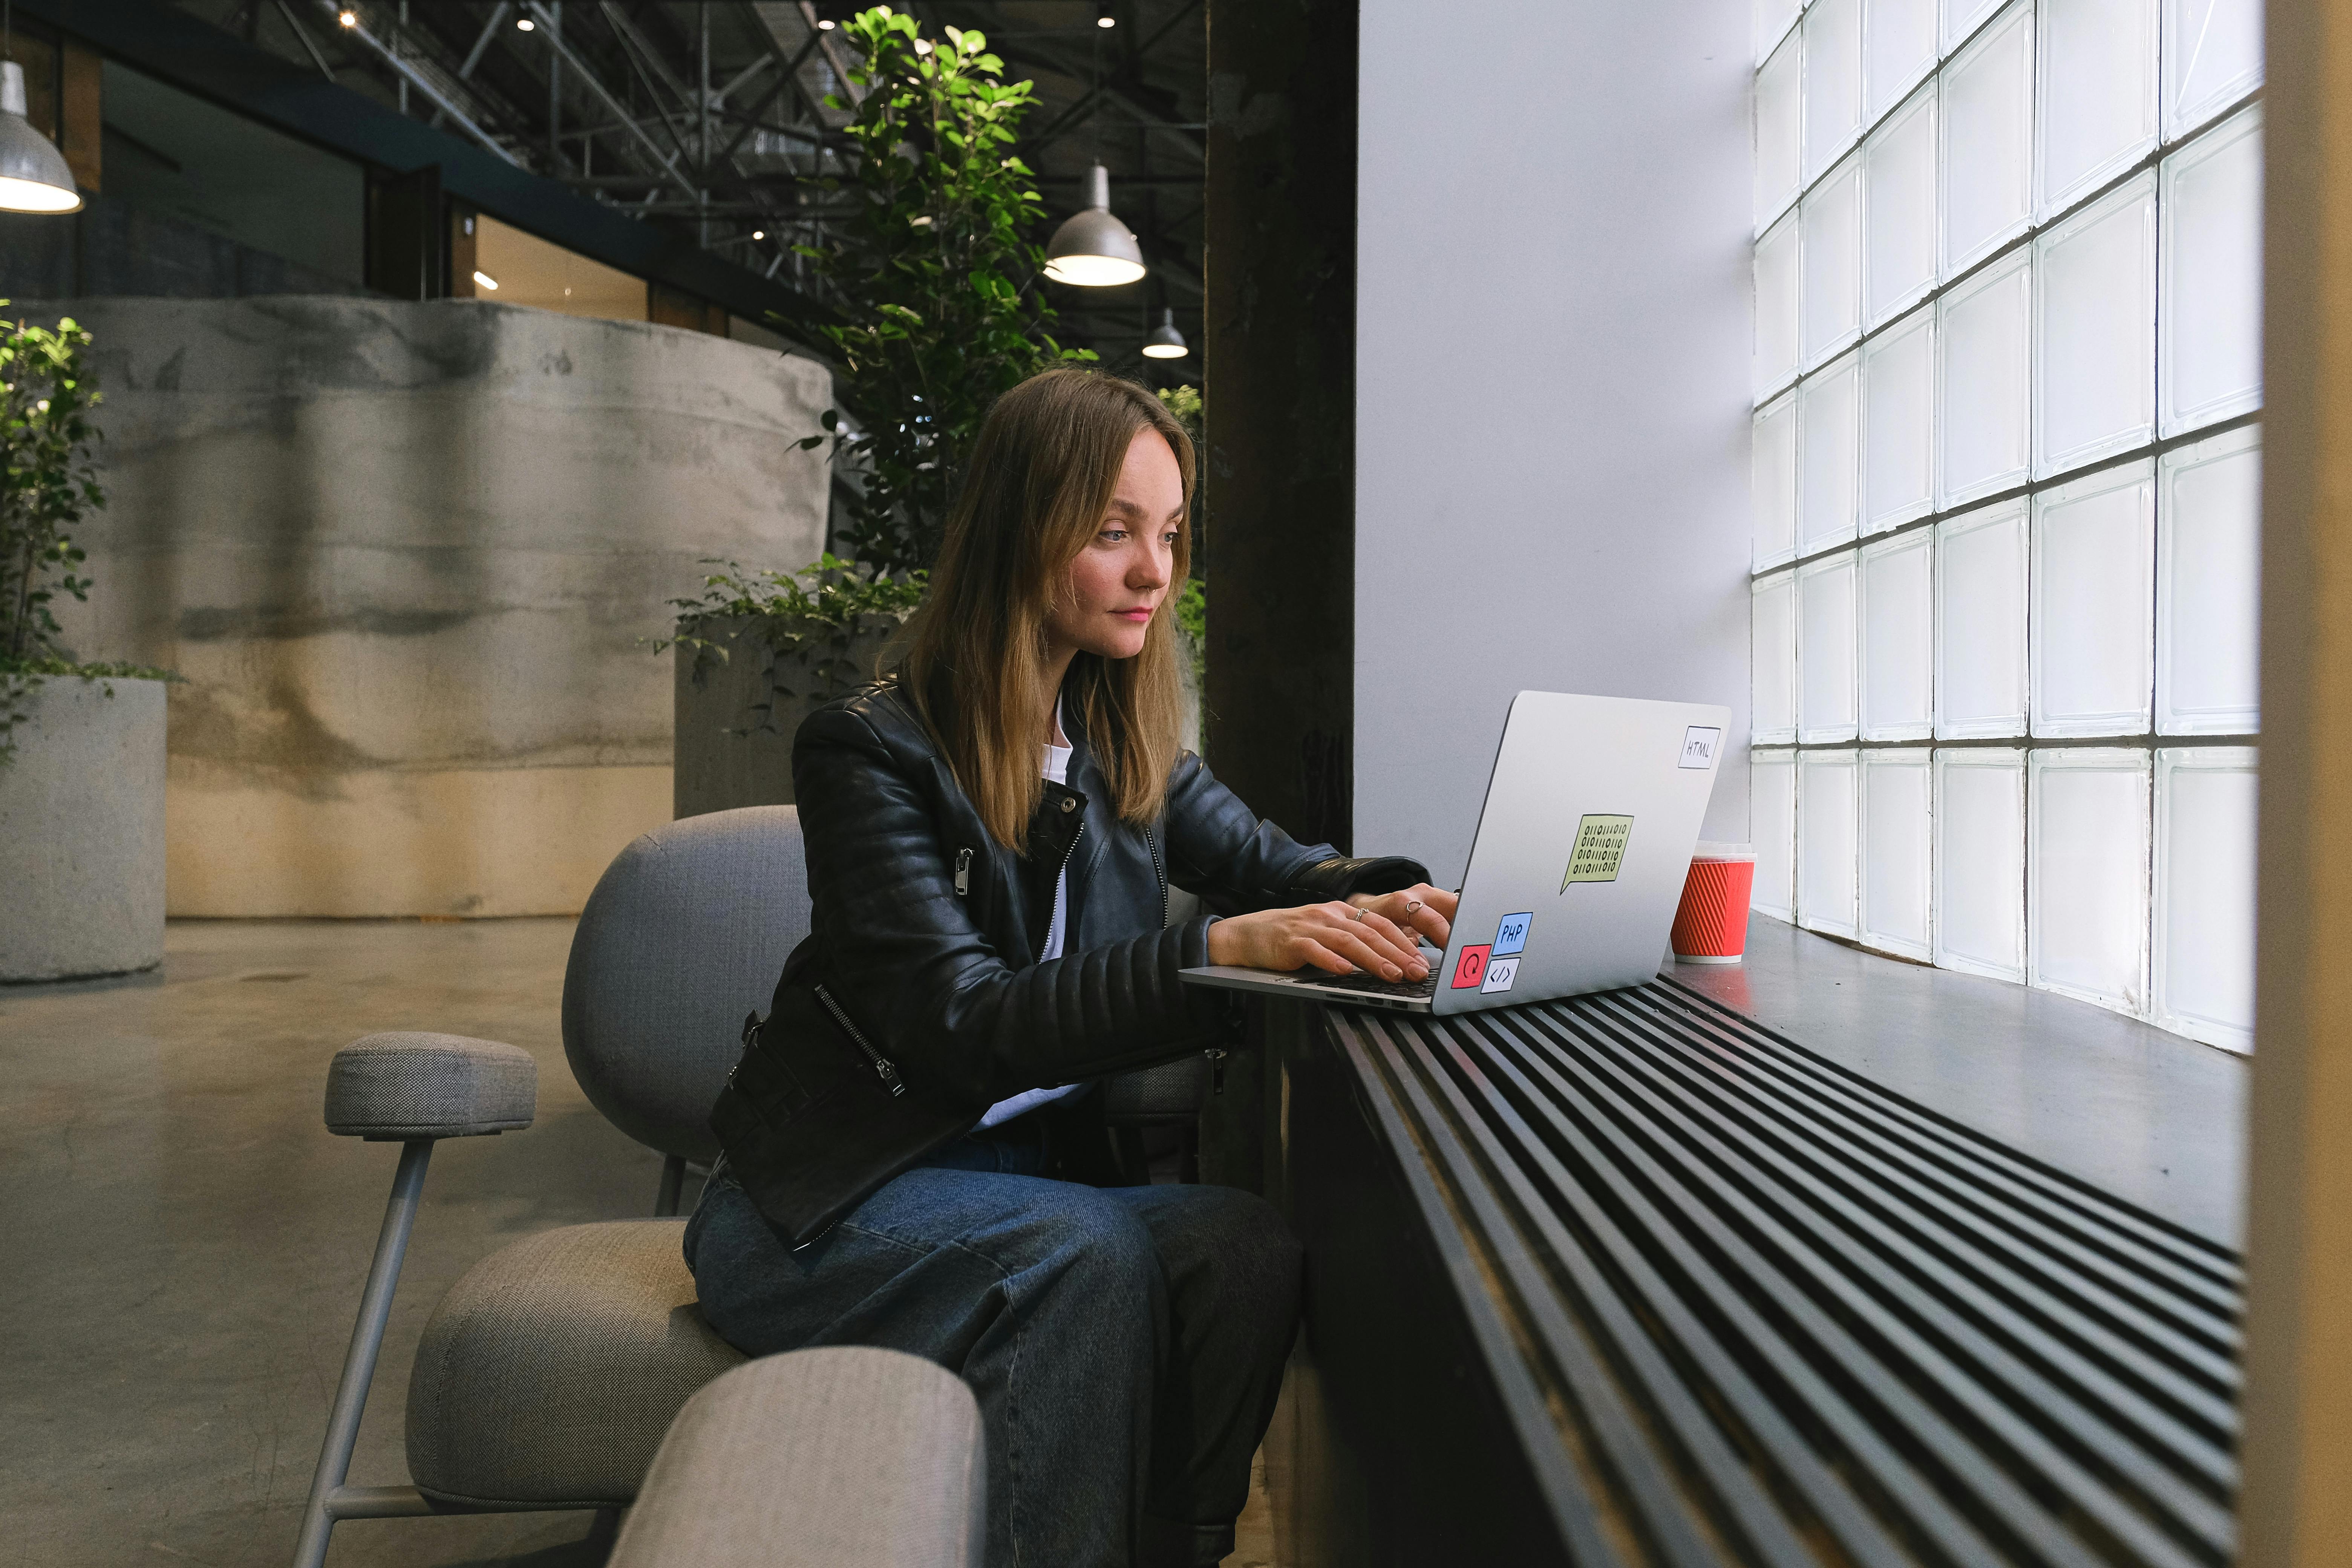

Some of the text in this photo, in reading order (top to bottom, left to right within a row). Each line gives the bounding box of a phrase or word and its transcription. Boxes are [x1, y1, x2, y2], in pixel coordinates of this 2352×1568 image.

[1687, 740, 1709, 758] HTML
[1585, 824, 1627, 836] 0110111010
[1582, 836, 1622, 848] 0101110110
[1578, 849, 1618, 861] 0101110110
[1573, 862, 1615, 874] 0110111010
[1501, 924, 1522, 943] PHP
